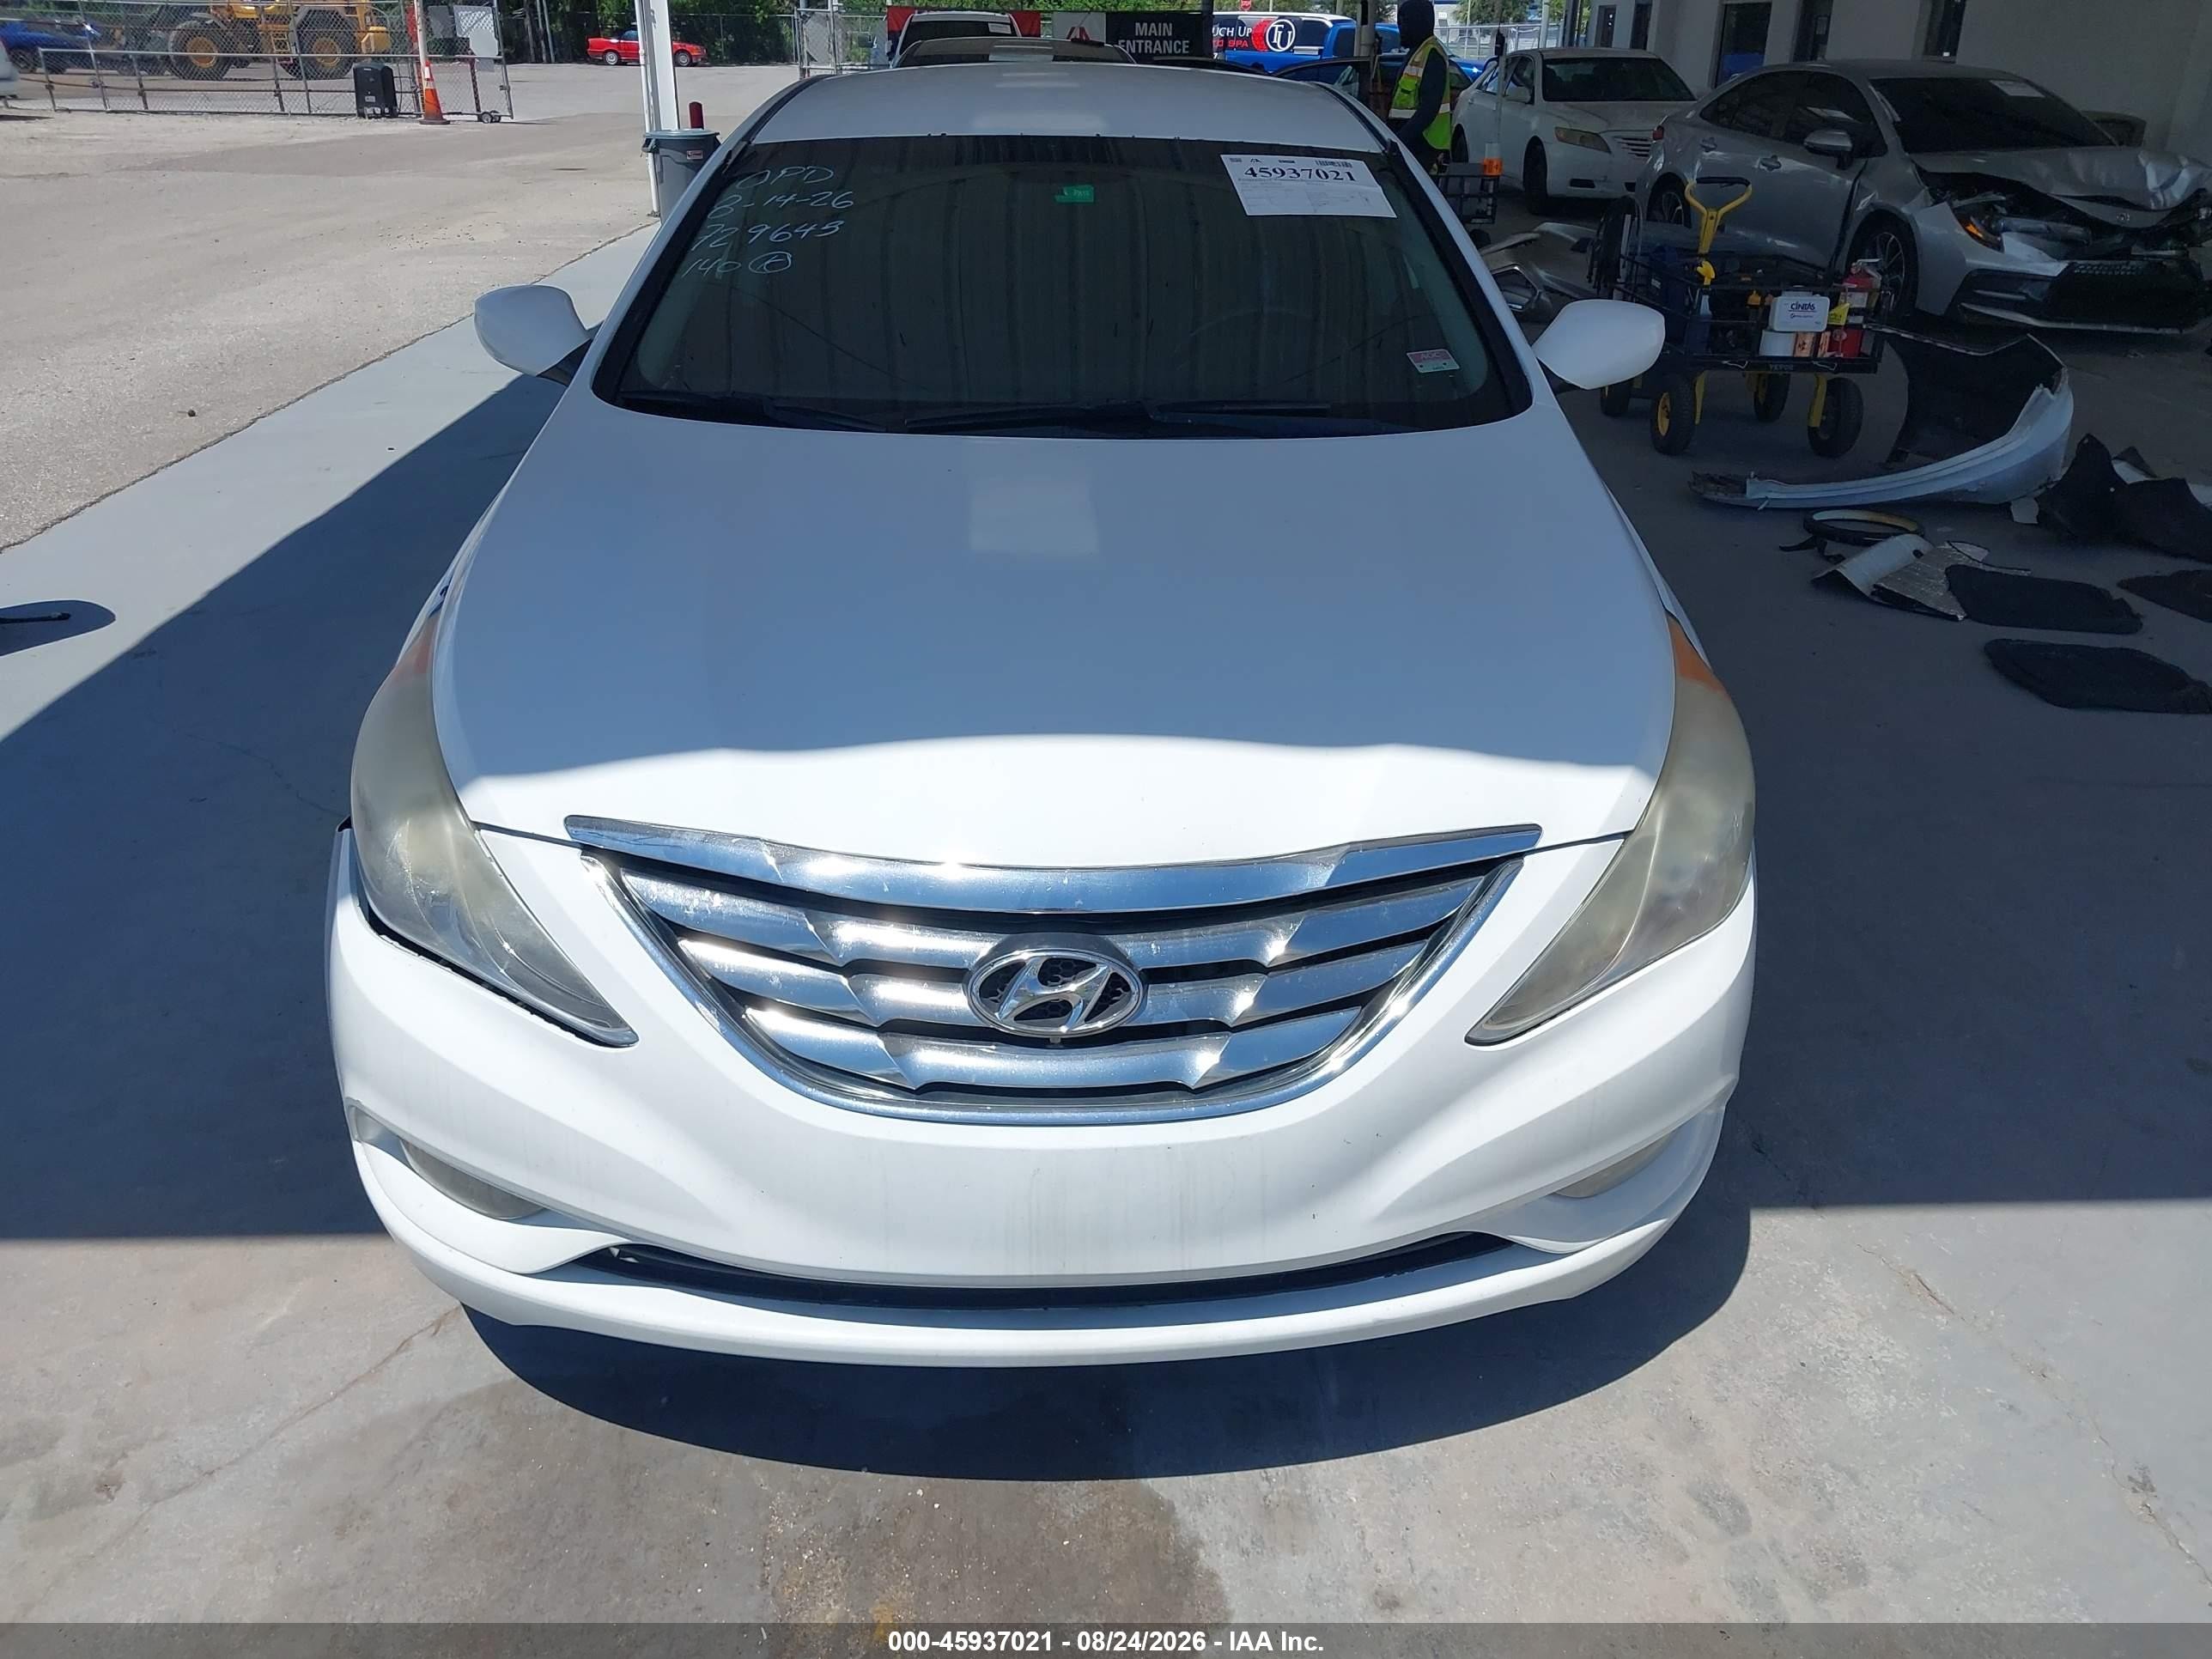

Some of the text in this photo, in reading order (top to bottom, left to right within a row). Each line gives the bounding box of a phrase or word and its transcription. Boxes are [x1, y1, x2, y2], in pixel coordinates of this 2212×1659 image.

[1134, 22, 1172, 36] MAIN
[1118, 40, 1189, 54] ENTRANCE
[1243, 167, 1356, 182] 45937021
[707, 191, 854, 219] 8-14-26
[1790, 301, 1816, 311] CINTAS
